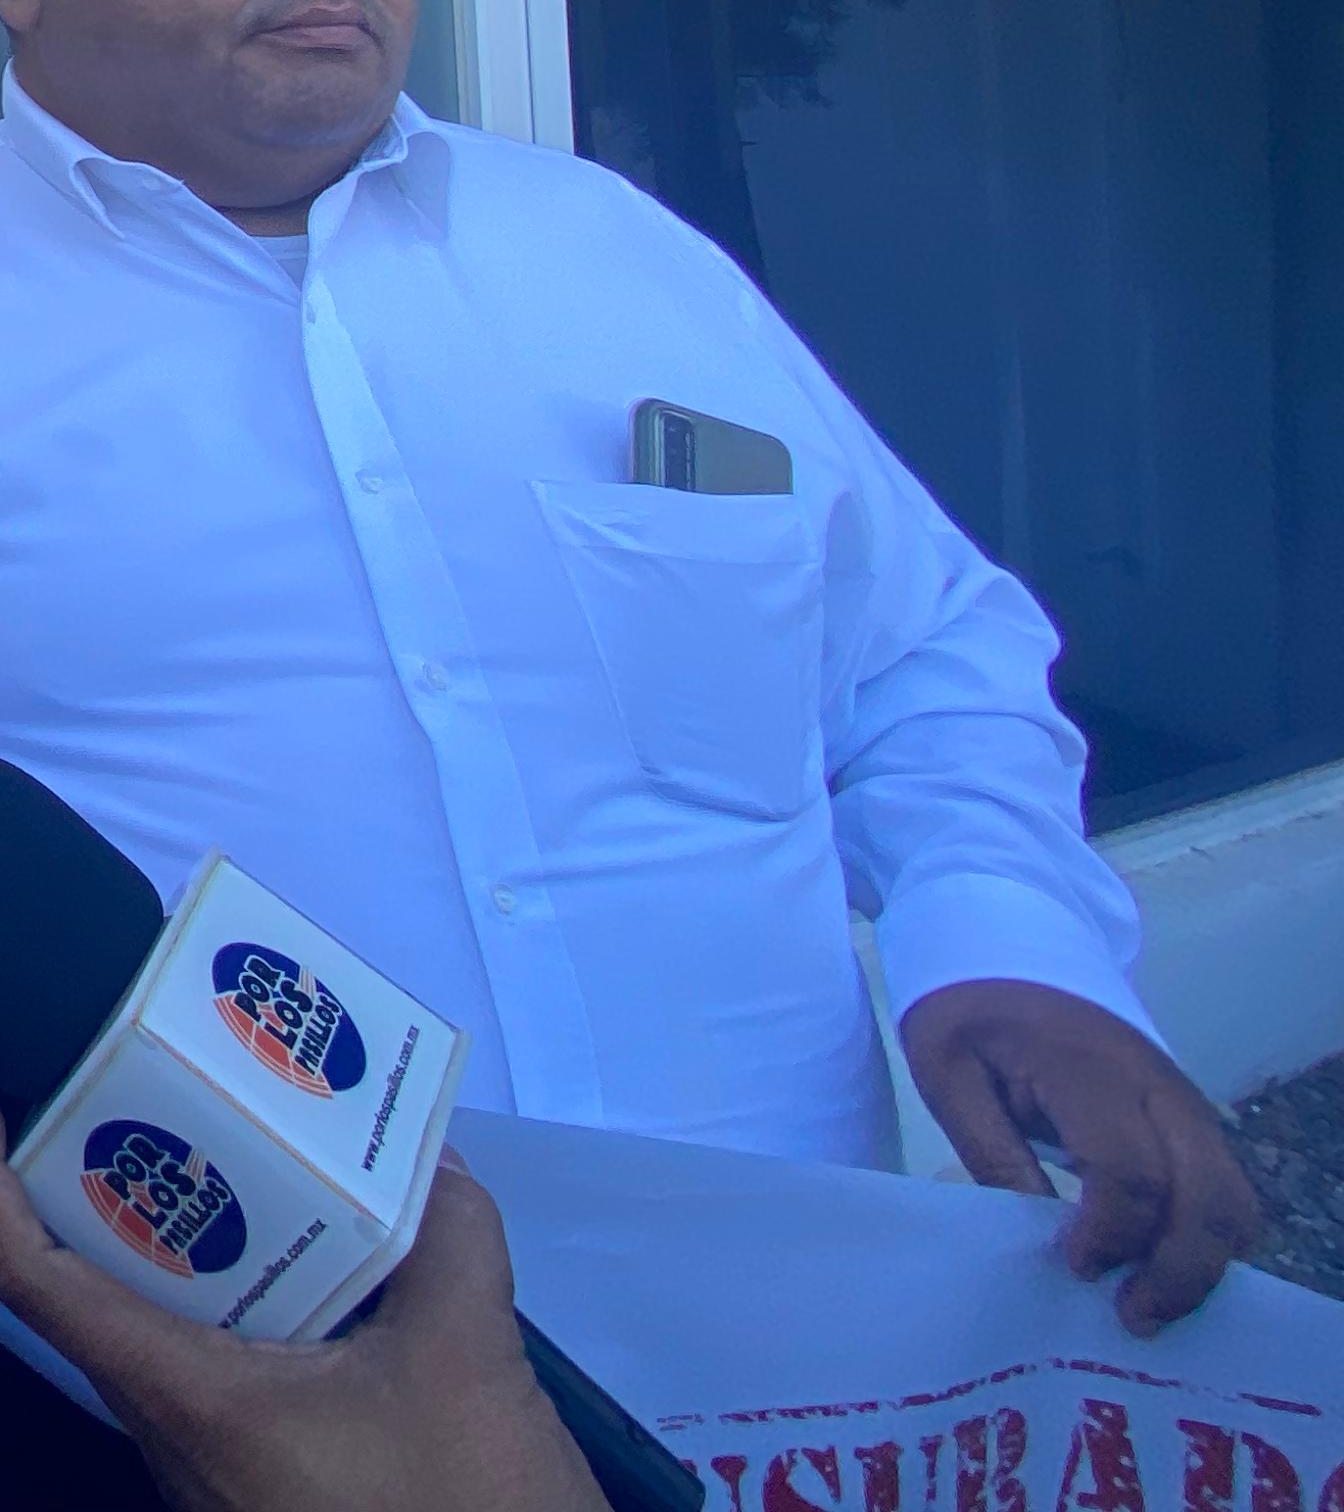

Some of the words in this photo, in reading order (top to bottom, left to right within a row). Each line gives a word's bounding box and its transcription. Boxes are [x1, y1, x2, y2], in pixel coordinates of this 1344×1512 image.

[233, 956, 284, 1023] POR
[264, 979, 313, 1050] LOS
[294, 994, 343, 1076] PASILLOS
[361, 1022, 421, 1173] www.porlospasillos.com.mx
[103, 1135, 166, 1200] POR
[132, 1161, 197, 1230] LOS
[159, 1180, 230, 1256] PASILLOS
